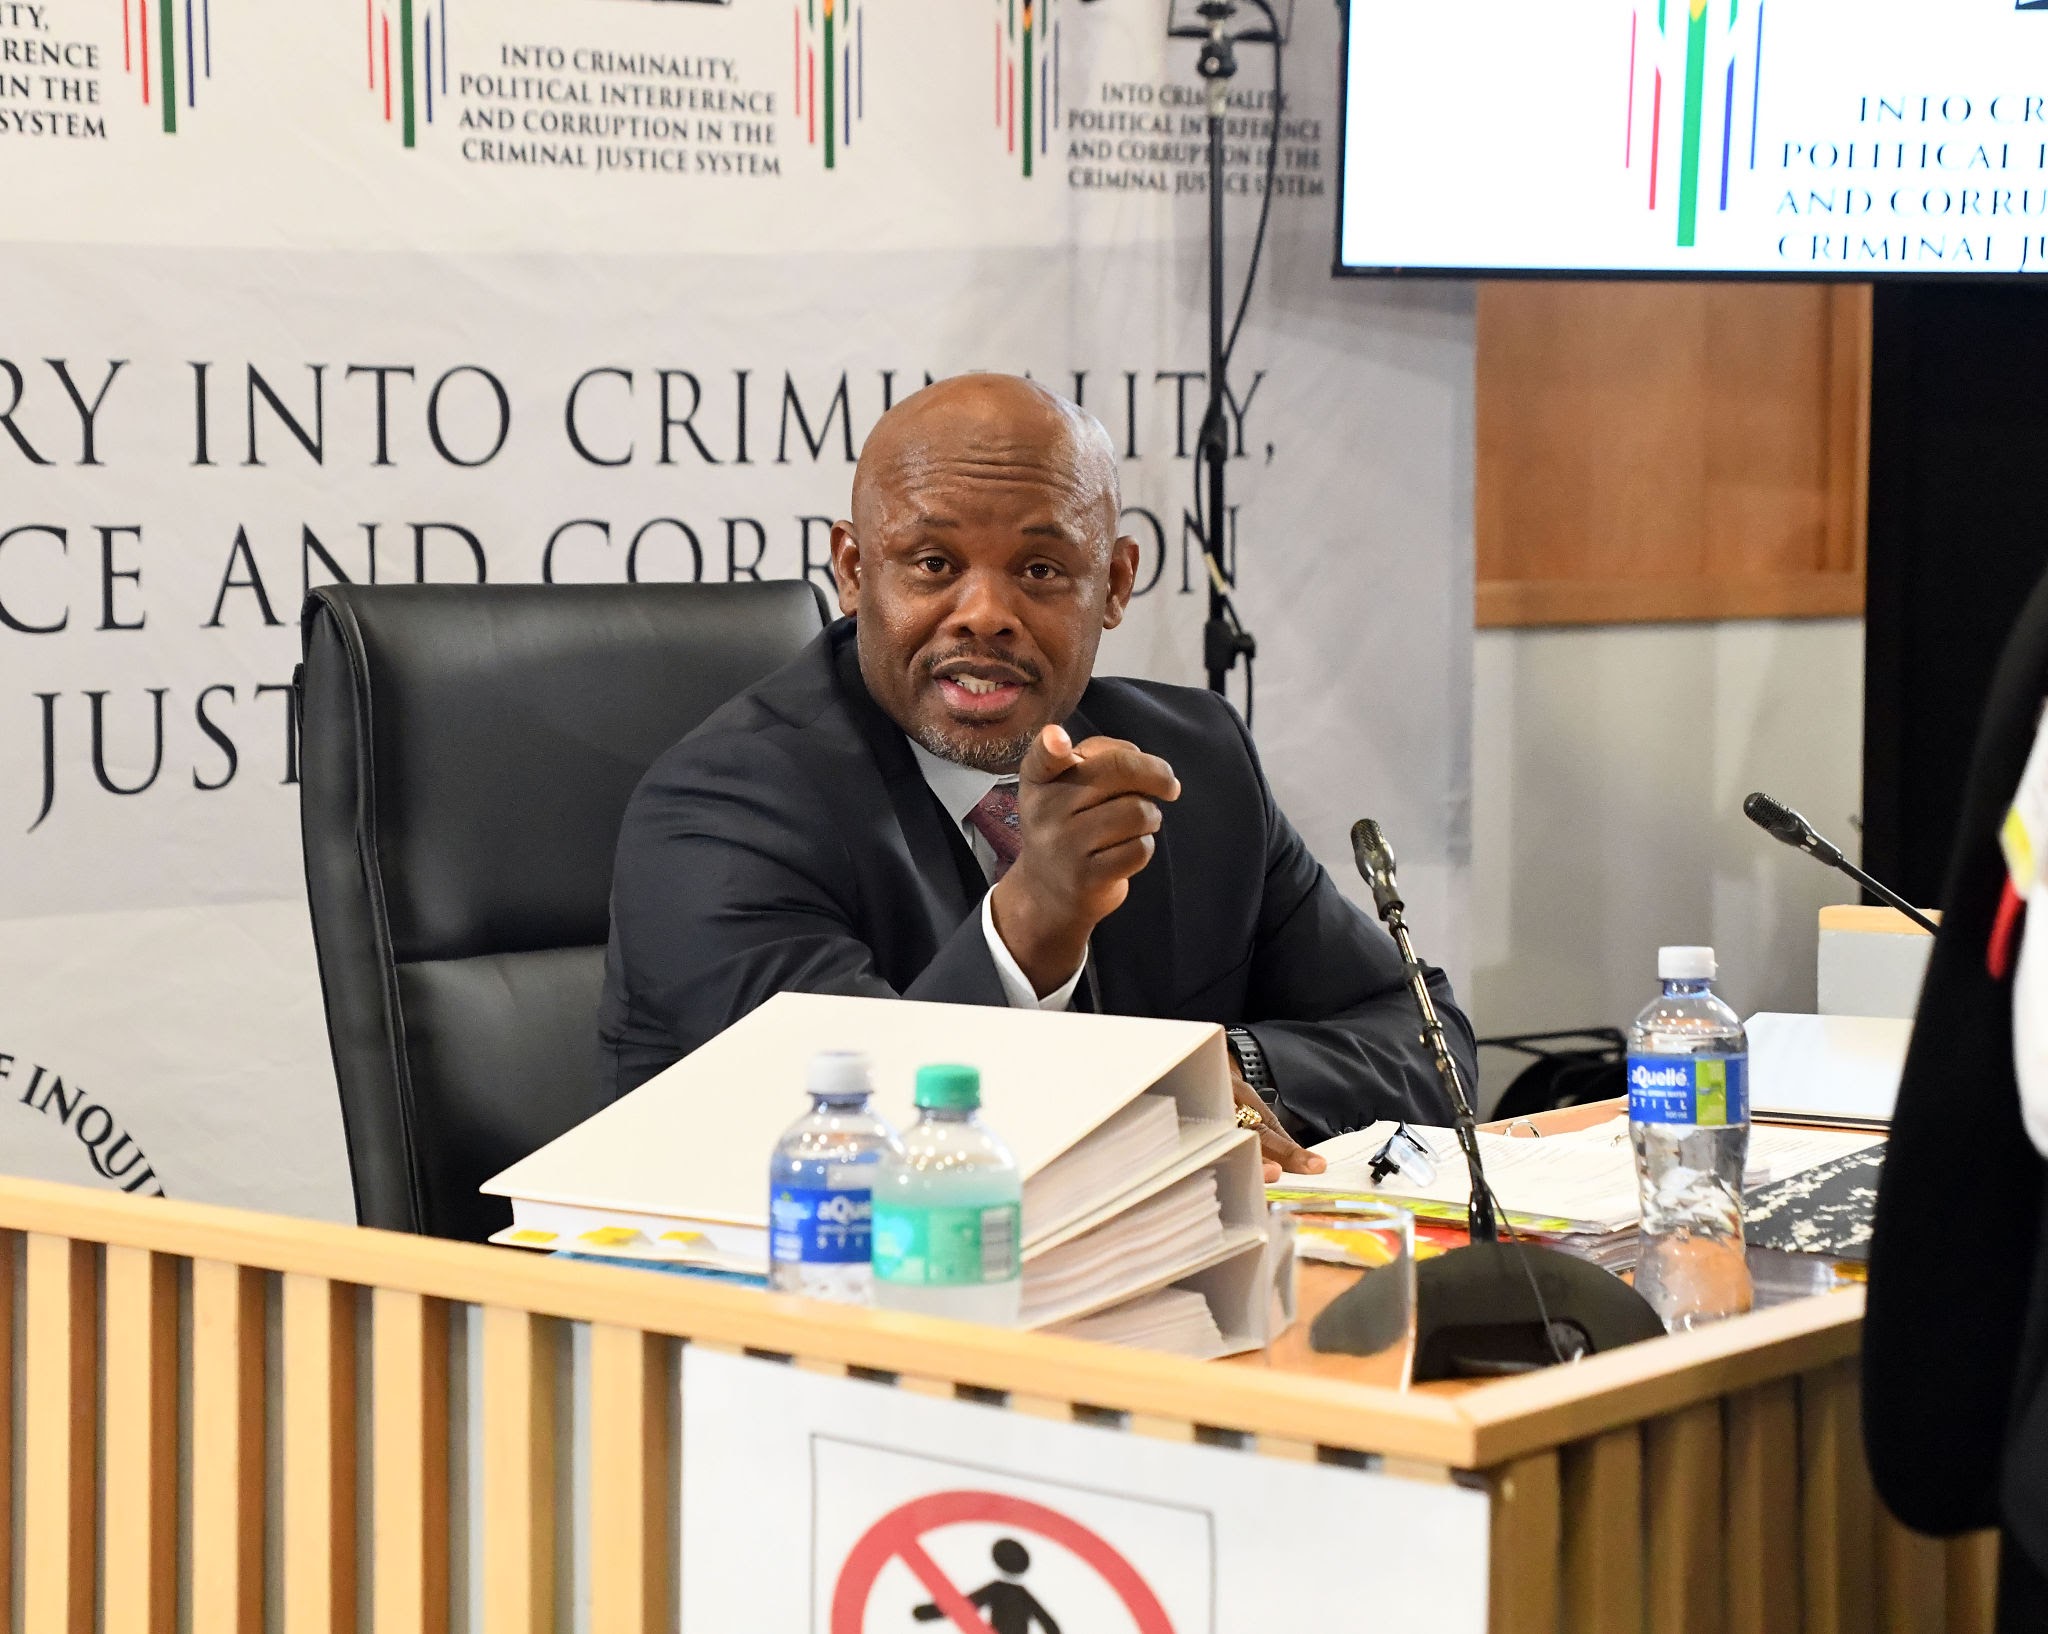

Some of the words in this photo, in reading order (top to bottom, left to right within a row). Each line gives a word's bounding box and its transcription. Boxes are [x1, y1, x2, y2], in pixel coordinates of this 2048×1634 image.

[3, 38, 98, 69] RENCE
[501, 45, 566, 68] INTO
[572, 49, 739, 83] CRIMINALITY,
[40, 75, 99, 103] THE
[459, 73, 592, 104] POLITICAL
[601, 82, 777, 115] INTERFERENCE
[1101, 82, 1154, 104] INTO
[0, 108, 106, 138] SYSTEM
[1067, 108, 1172, 135] POLITICAL
[1859, 96, 1972, 122] INTO
[1990, 96, 2048, 122] CR
[458, 106, 515, 131] AND
[522, 109, 690, 141] CORRUPTION
[697, 118, 722, 142] IN
[731, 120, 777, 146] THE
[461, 138, 587, 167] CRIMINAL
[596, 144, 689, 174] JUSTICE
[694, 150, 782, 177] SYSTEM
[1067, 139, 1112, 160] AND
[1117, 140, 1250, 165] CORRUPON
[1782, 143, 2014, 169] POLITICAL
[1067, 166, 1168, 191] CRIMINAL
[1174, 170, 1249, 196] JUSCE
[1777, 190, 1872, 215] AND
[1890, 190, 2048, 216] CORRU
[0, 358, 130, 467] RY
[186, 360, 511, 468] INTO
[565, 366, 1275, 468] CRIMITY,
[0, 524, 147, 634] CE
[200, 521, 488, 629] AND
[541, 504, 1241, 604] CORRON
[18, 1063, 167, 1199] INQUI
